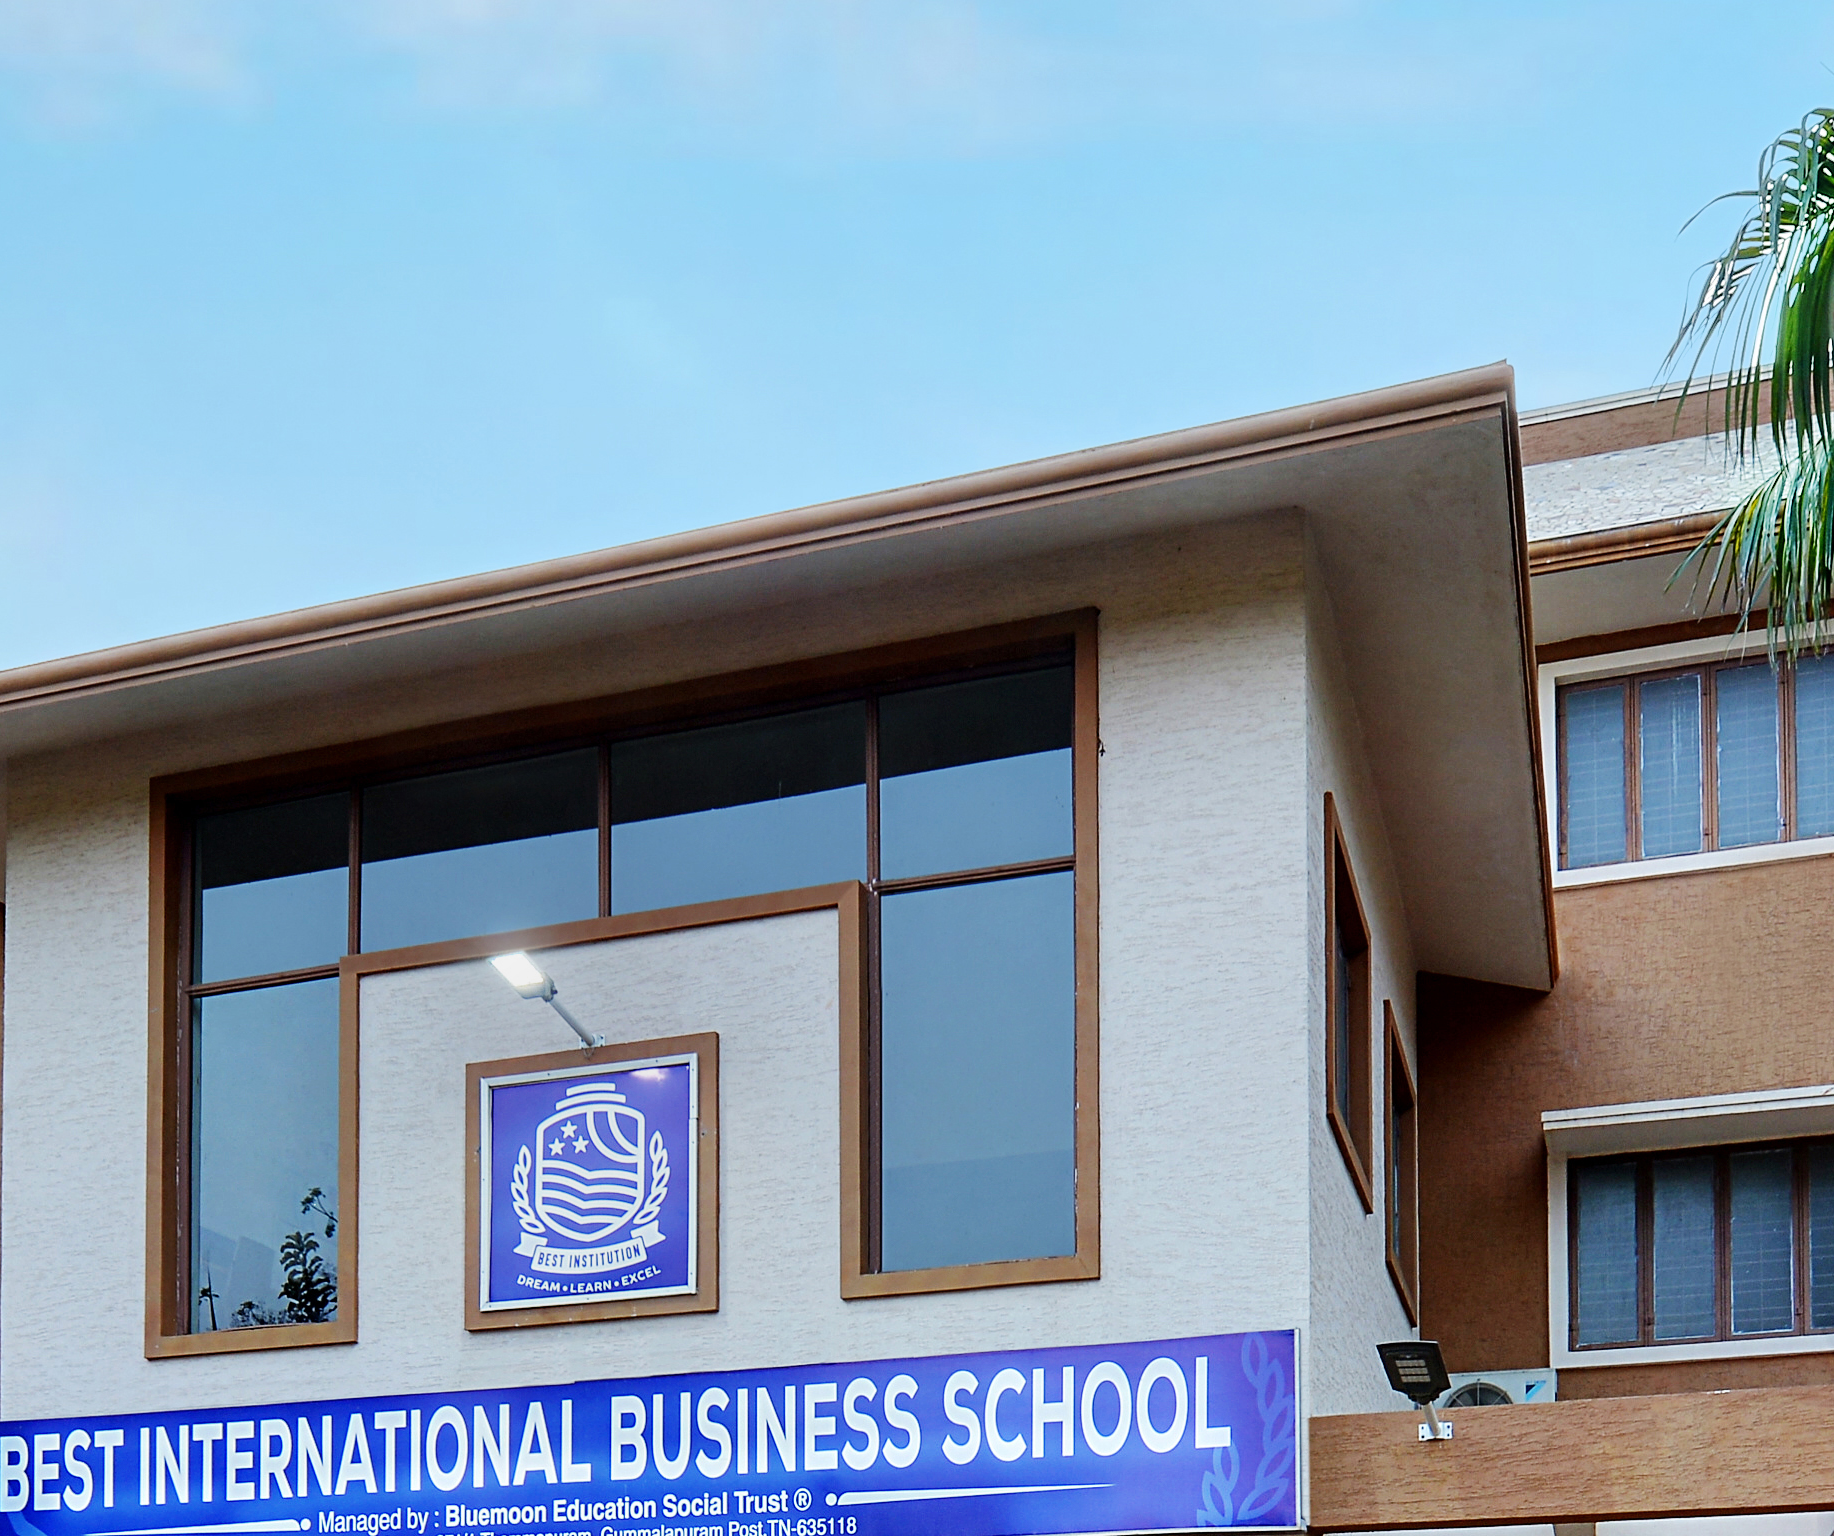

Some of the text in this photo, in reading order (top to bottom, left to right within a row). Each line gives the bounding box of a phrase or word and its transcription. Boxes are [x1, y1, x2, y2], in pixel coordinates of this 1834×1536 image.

[537, 1243, 642, 1268] BEST INSTITUTION
[517, 1265, 662, 1294] DREAM LEARN EXCEL
[0, 1351, 1231, 1513] BEST INTERNATIONAL BUSINESS SCHOOL
[318, 1507, 402, 1533] Managed
[407, 1507, 429, 1535] by
[445, 1503, 547, 1527] Bluemoon
[553, 1496, 657, 1522] Education
[662, 1491, 728, 1518] Social
[733, 1489, 789, 1514] Trust
